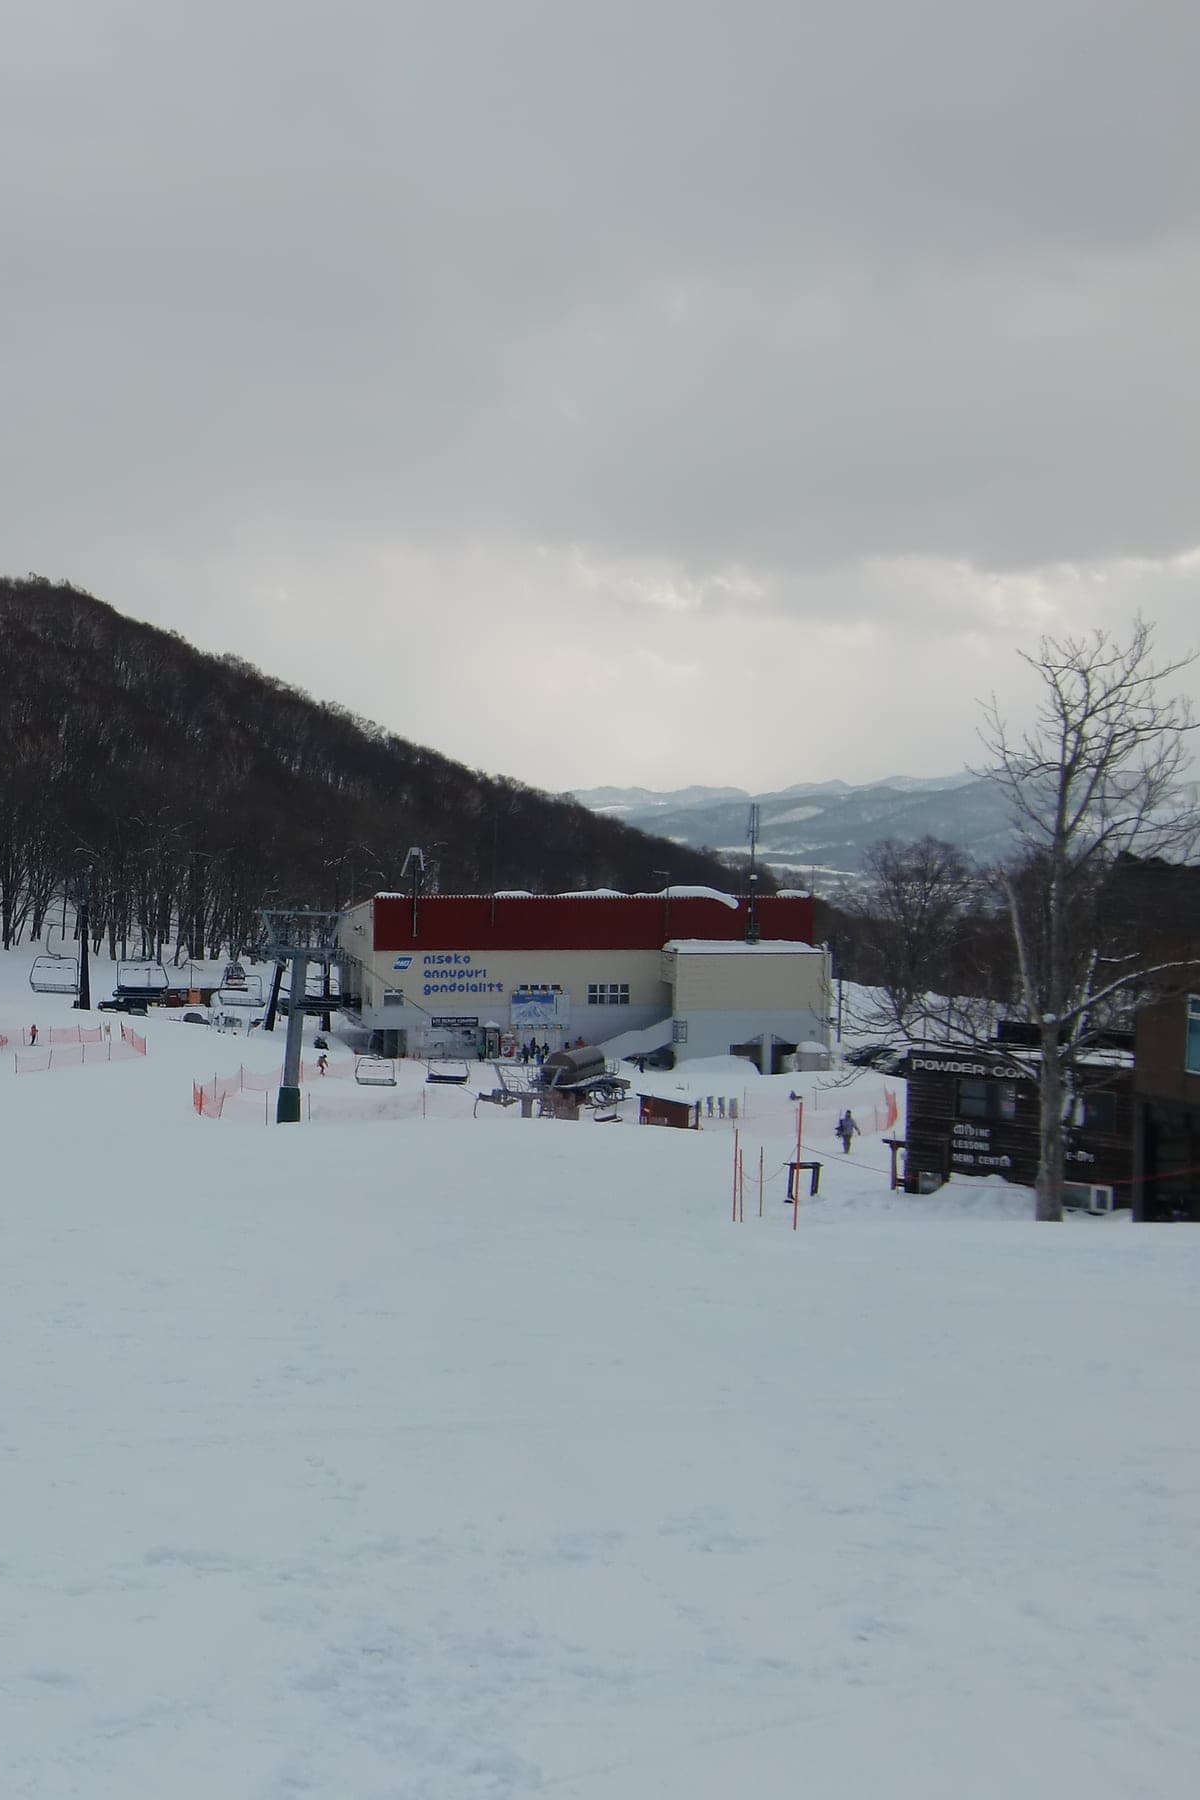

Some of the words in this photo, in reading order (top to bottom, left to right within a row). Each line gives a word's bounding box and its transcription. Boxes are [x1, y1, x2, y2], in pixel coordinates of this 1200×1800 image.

[423, 953, 471, 965] niseko
[423, 968, 487, 979] annupuri
[912, 1058, 985, 1075] POWDER
